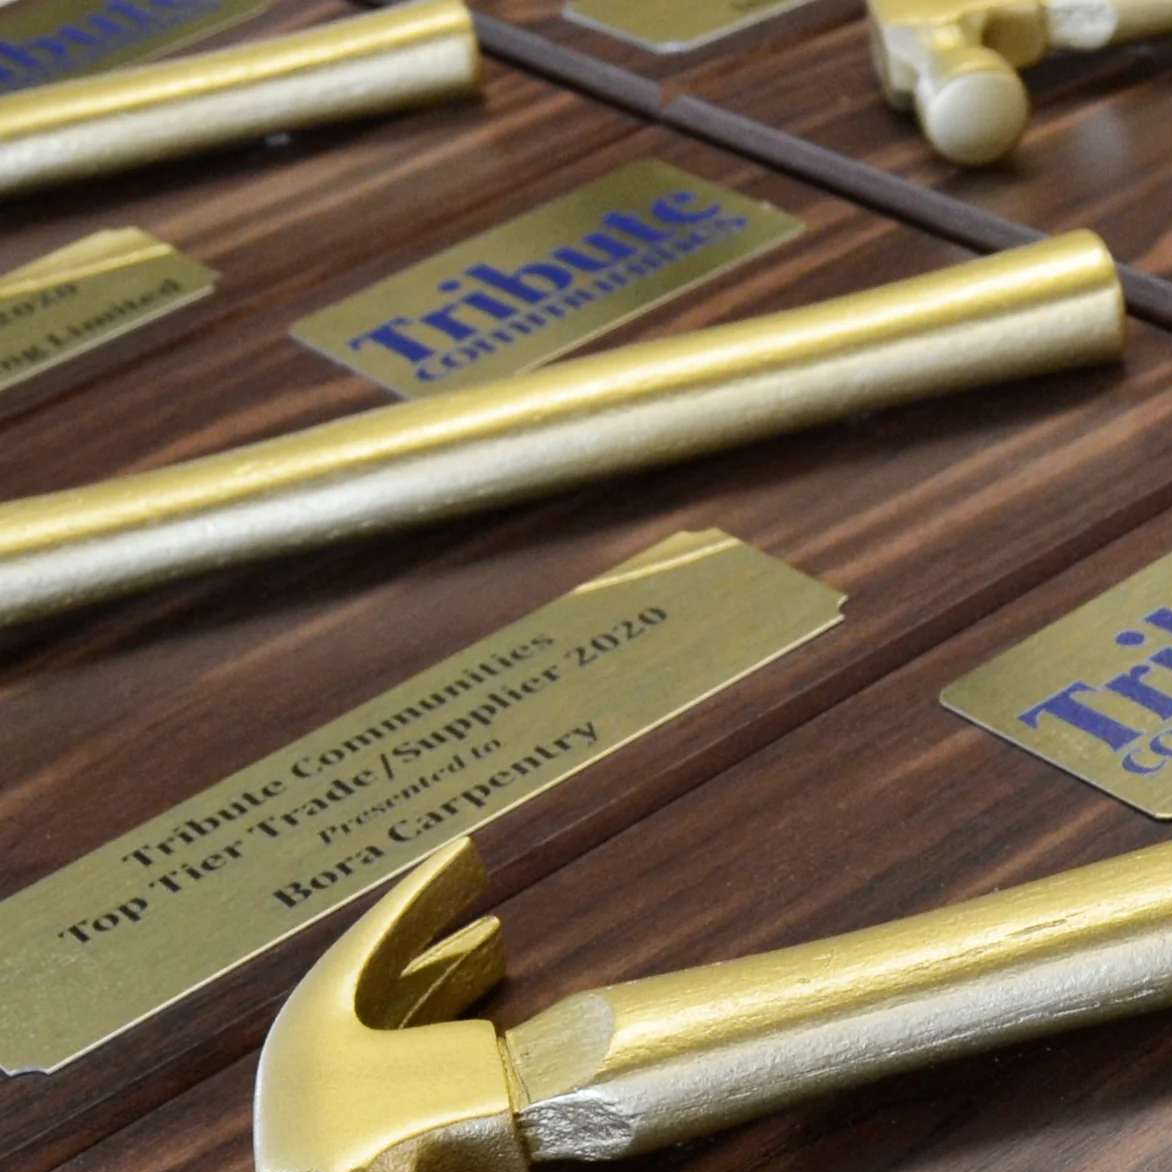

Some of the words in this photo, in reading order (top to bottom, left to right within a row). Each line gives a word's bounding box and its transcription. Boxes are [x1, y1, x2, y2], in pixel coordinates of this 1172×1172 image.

[346, 192, 721, 364] Tribute
[57, 895, 149, 947] Top
[147, 843, 243, 900] Tier
[246, 664, 561, 843] Trade/Supplier
[563, 605, 669, 668] 2020
[121, 774, 287, 870] Tribute
[290, 630, 557, 783] Communities
[271, 843, 387, 910] Bora
[386, 720, 600, 845] Carpentry
[318, 756, 470, 846] Presented
[468, 738, 503, 767] to
